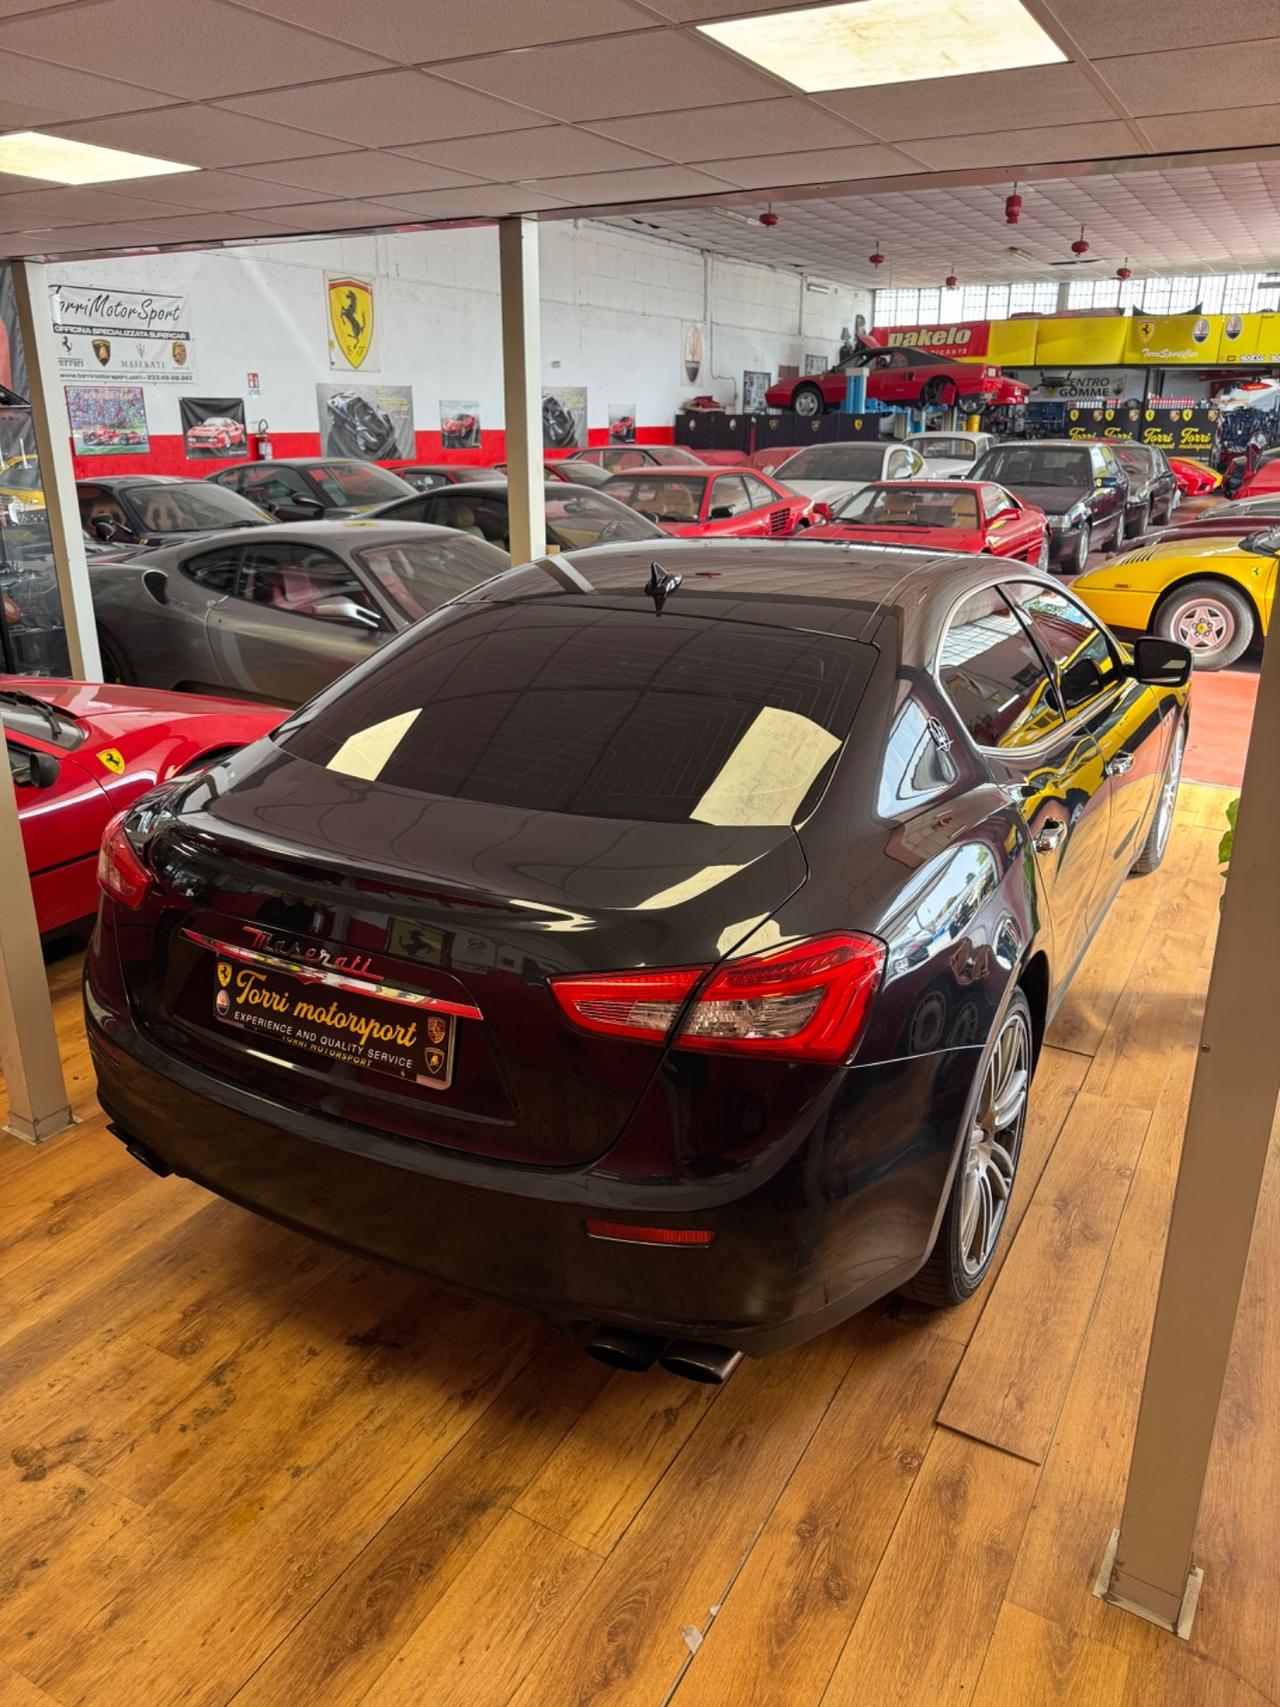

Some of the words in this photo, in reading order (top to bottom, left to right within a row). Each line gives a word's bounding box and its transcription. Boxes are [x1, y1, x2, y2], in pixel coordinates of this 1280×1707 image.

[54, 325, 92, 334] OFFICINA
[92, 328, 149, 338] SPECIALIZZATA
[149, 331, 186, 339] SUPERCAR
[887, 327, 971, 347] pakelo
[121, 360, 165, 369] MASERATI
[1070, 378, 1110, 387] ENTRO
[1059, 388, 1111, 397] GOMME
[1143, 427, 1174, 444] Torri
[1180, 427, 1212, 444] Torri
[242, 925, 385, 982] Maserati
[236, 969, 290, 1013] Torri
[293, 1001, 418, 1047] motorsport
[234, 1011, 293, 1036] EXPERIENCE
[296, 1027, 318, 1043] AND
[320, 1034, 365, 1056] QUALITY
[367, 1049, 413, 1070] SERVICE
